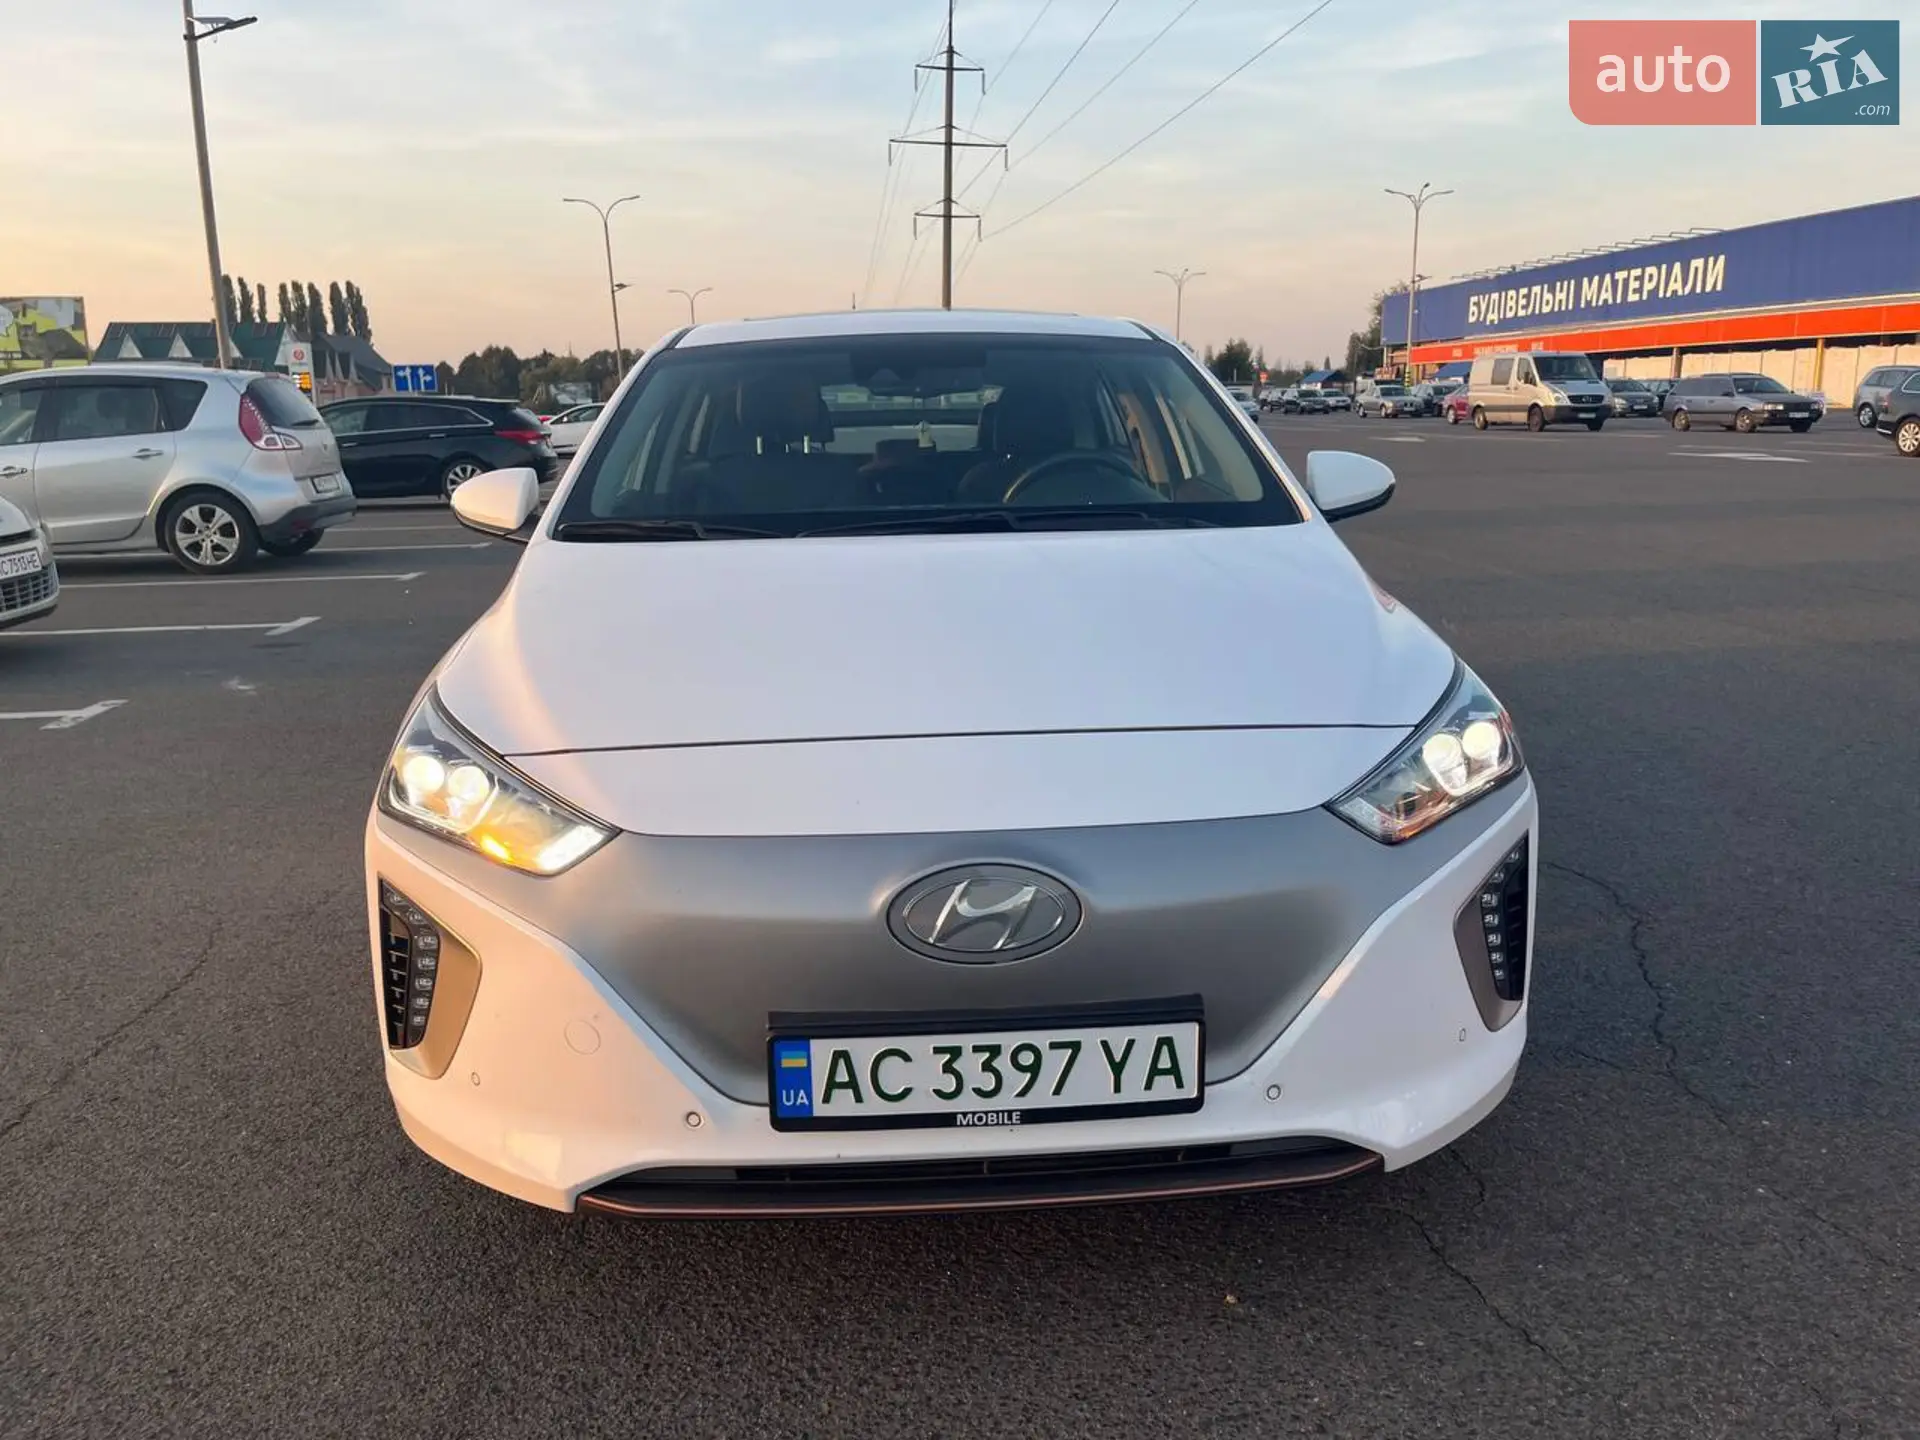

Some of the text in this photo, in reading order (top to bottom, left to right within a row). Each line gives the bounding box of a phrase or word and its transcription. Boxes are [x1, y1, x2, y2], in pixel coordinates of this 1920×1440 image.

[1468, 255, 1726, 325] БУДІВЕЛЬНІ МАТЕРІАЛИ
[821, 1036, 1186, 1105] AC 3397 YA
[782, 1090, 809, 1106] UA
[956, 1111, 1021, 1126] MOBILE
